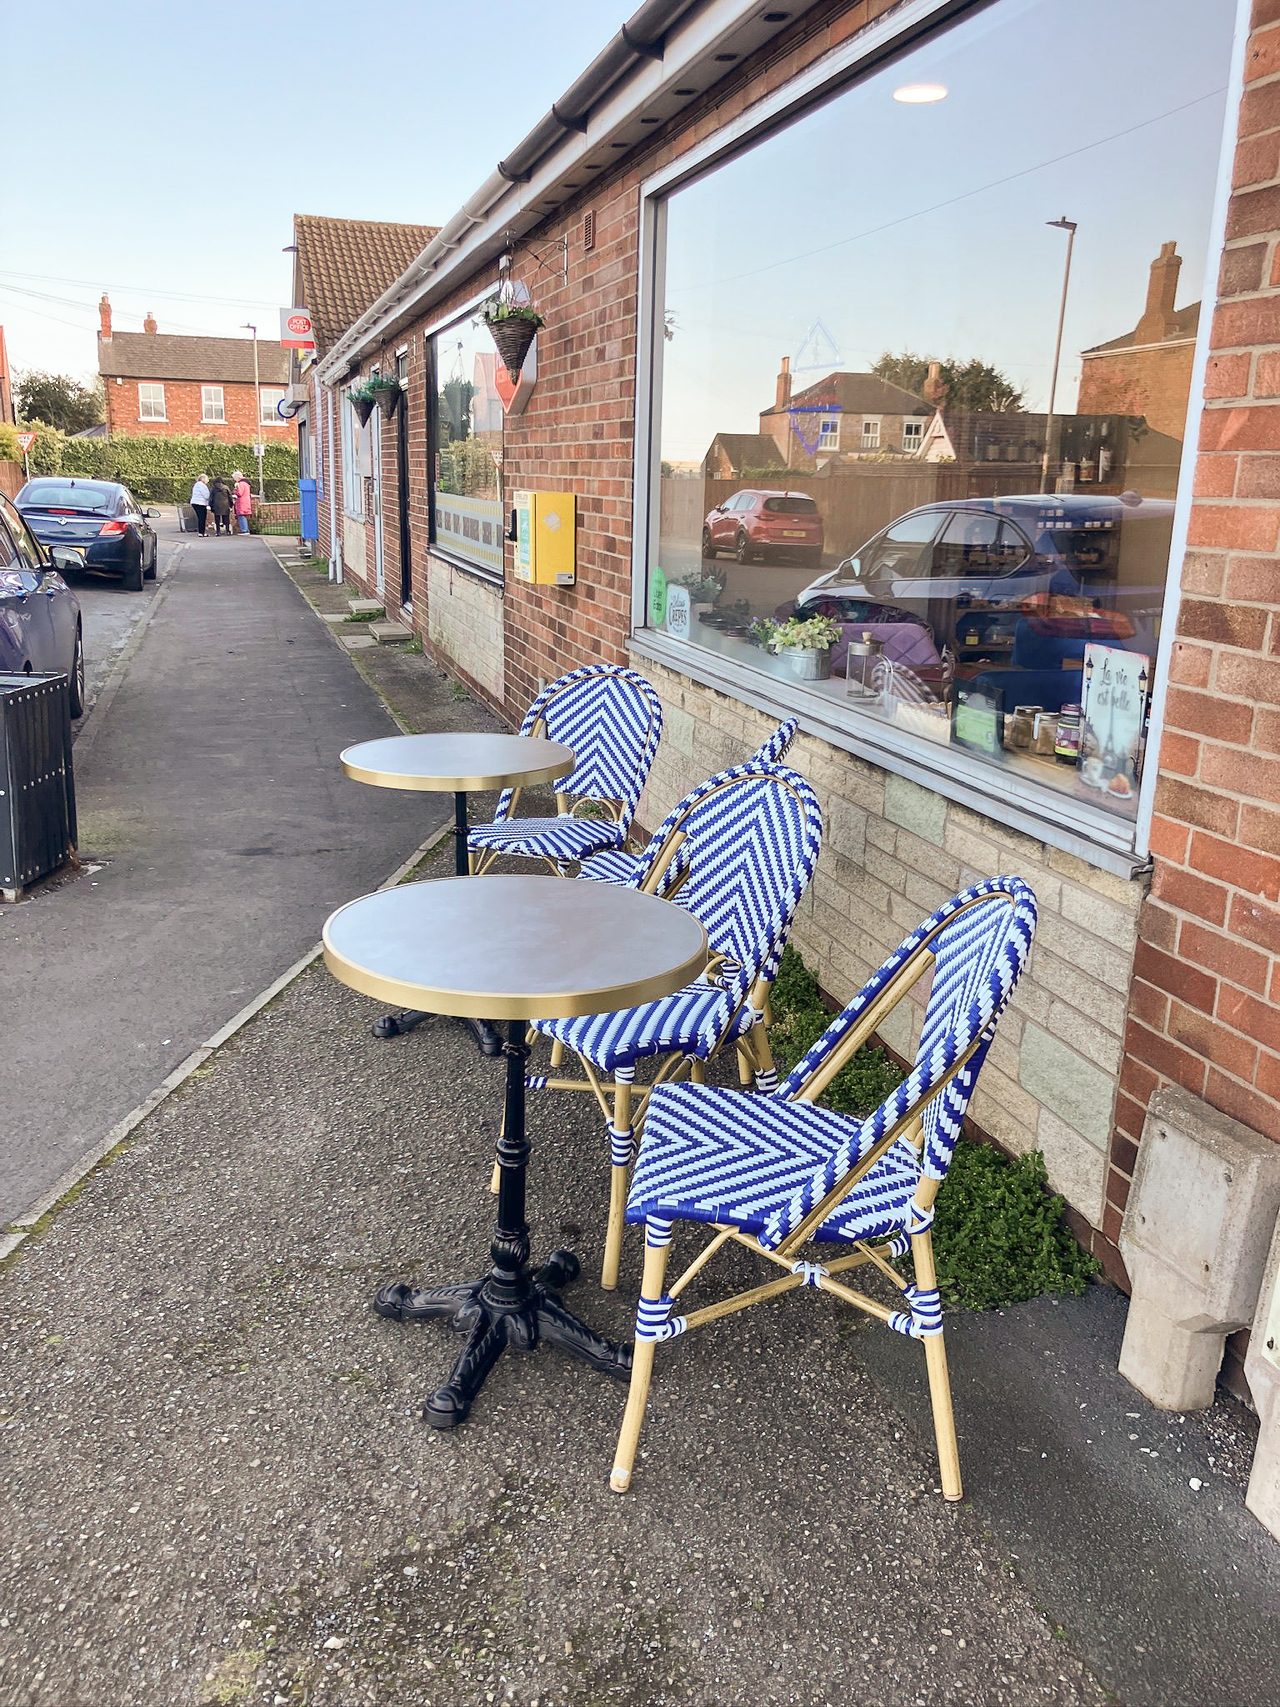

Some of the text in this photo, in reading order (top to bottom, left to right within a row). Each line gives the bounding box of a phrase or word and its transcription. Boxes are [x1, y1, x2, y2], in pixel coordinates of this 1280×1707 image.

[1100, 657, 1128, 687] La vie
[1097, 686, 1131, 711] est belle
